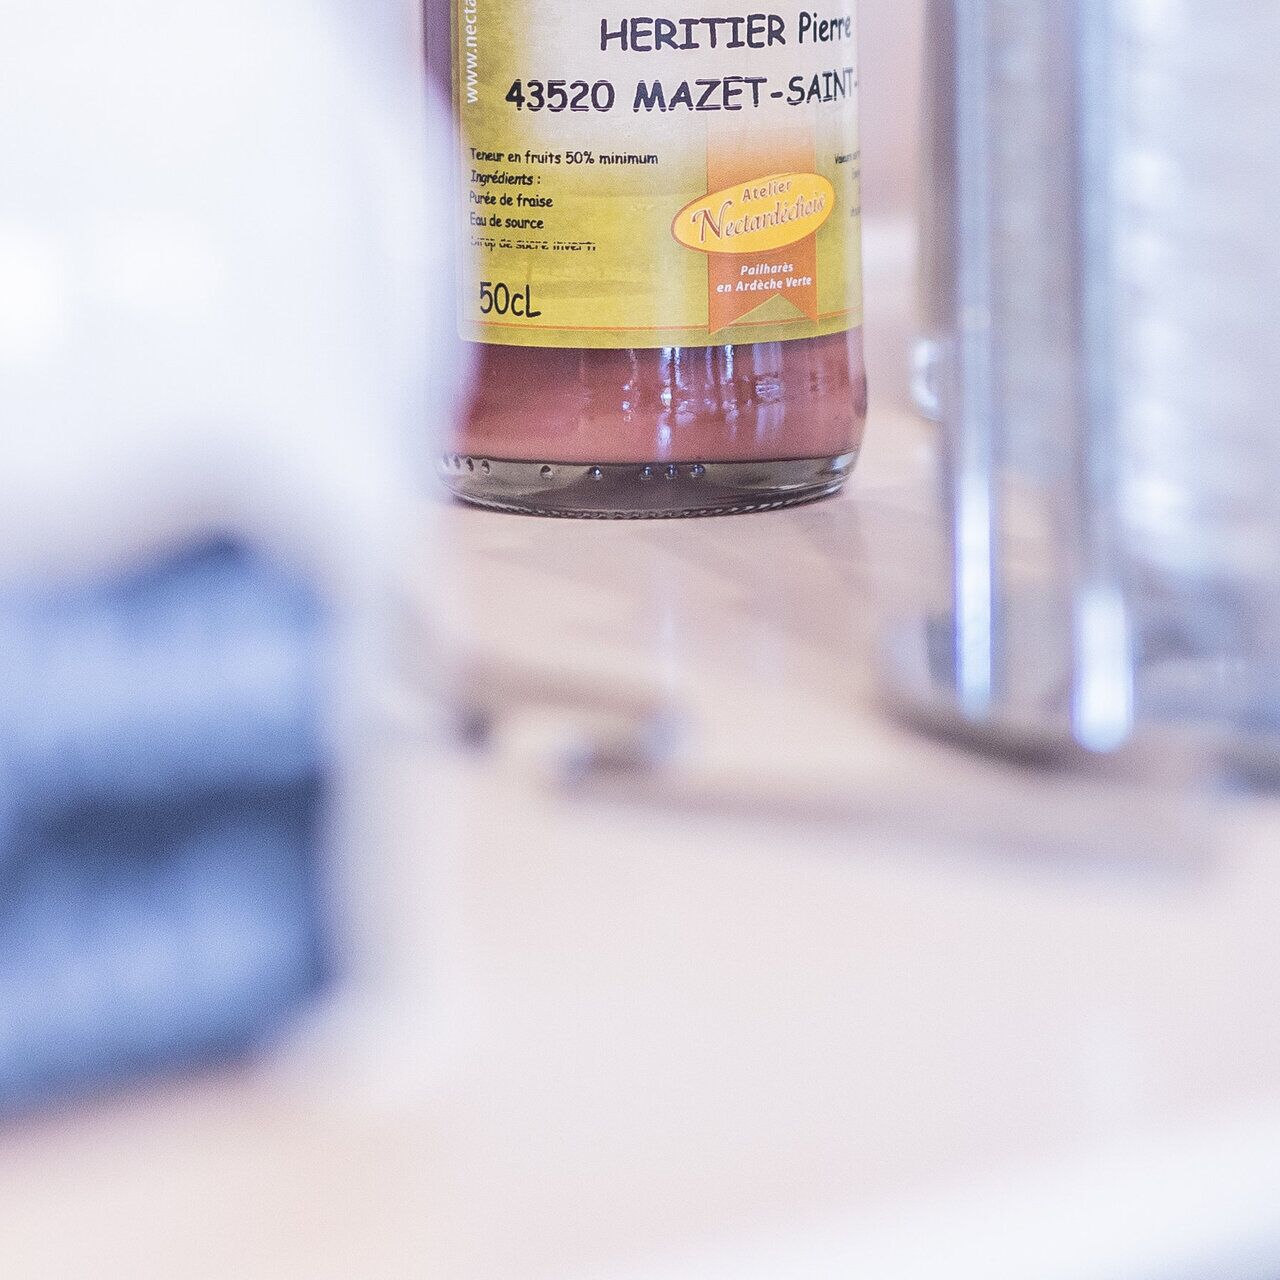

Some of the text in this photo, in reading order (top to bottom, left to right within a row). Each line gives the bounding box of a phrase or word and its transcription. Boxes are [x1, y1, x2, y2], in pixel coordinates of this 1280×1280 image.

[600, 10, 852, 52] HERITIER Pierre
[505, 78, 615, 112] 43520
[470, 147, 659, 165] Teneur en fruits 50% minimum
[470, 170, 533, 187] Ingrédients
[742, 179, 792, 202] Atelier
[469, 191, 553, 208] Purée de fraise
[470, 212, 544, 229] Eau de source
[740, 262, 794, 276] Pailharès
[716, 276, 812, 293] en Ardèche Verte
[479, 282, 542, 318] 50cL
